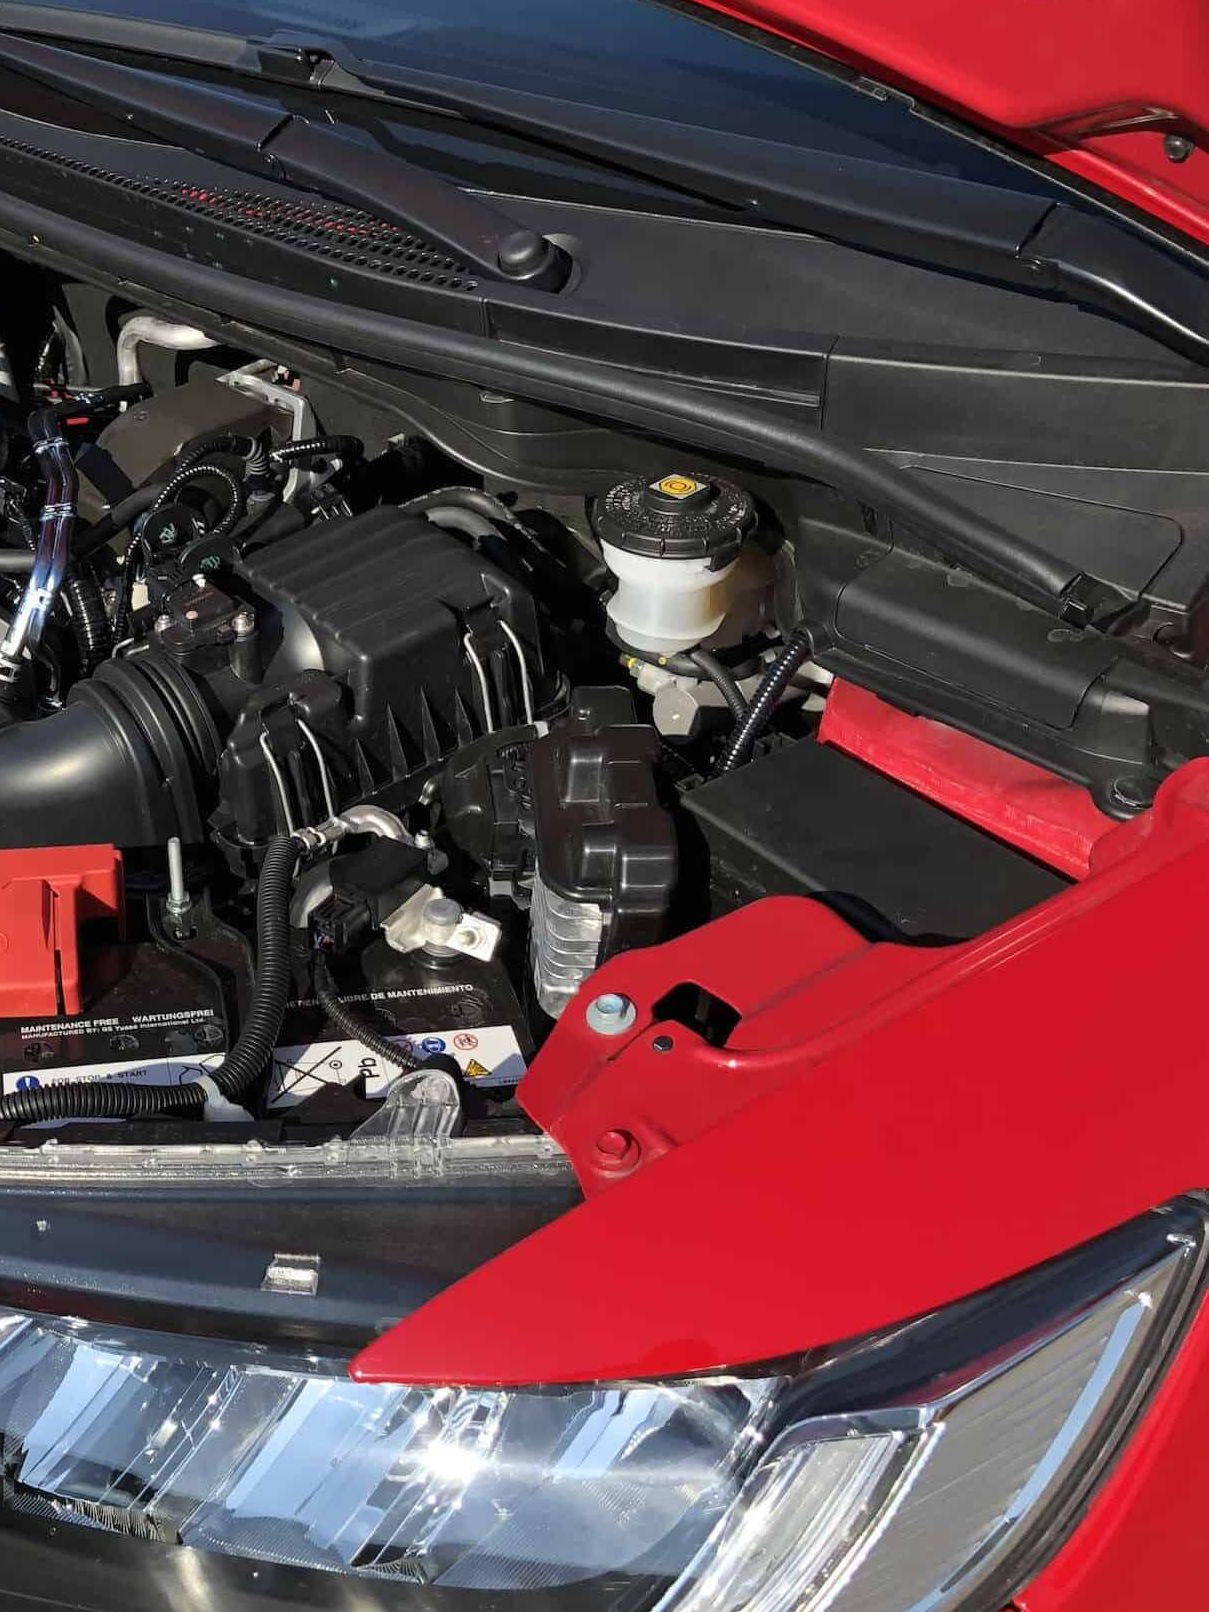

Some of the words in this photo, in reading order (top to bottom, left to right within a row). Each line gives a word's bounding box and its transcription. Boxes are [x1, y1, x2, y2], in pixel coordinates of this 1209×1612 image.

[370, 991, 386, 1000] DE
[387, 984, 474, 999] MANTENIMIENTO
[20, 1021, 92, 1034] MAINTENANCE
[93, 1017, 119, 1028] FREE
[132, 1009, 214, 1023] WARTUNGSFREI
[21, 1028, 85, 1040] MANUFACTURED
